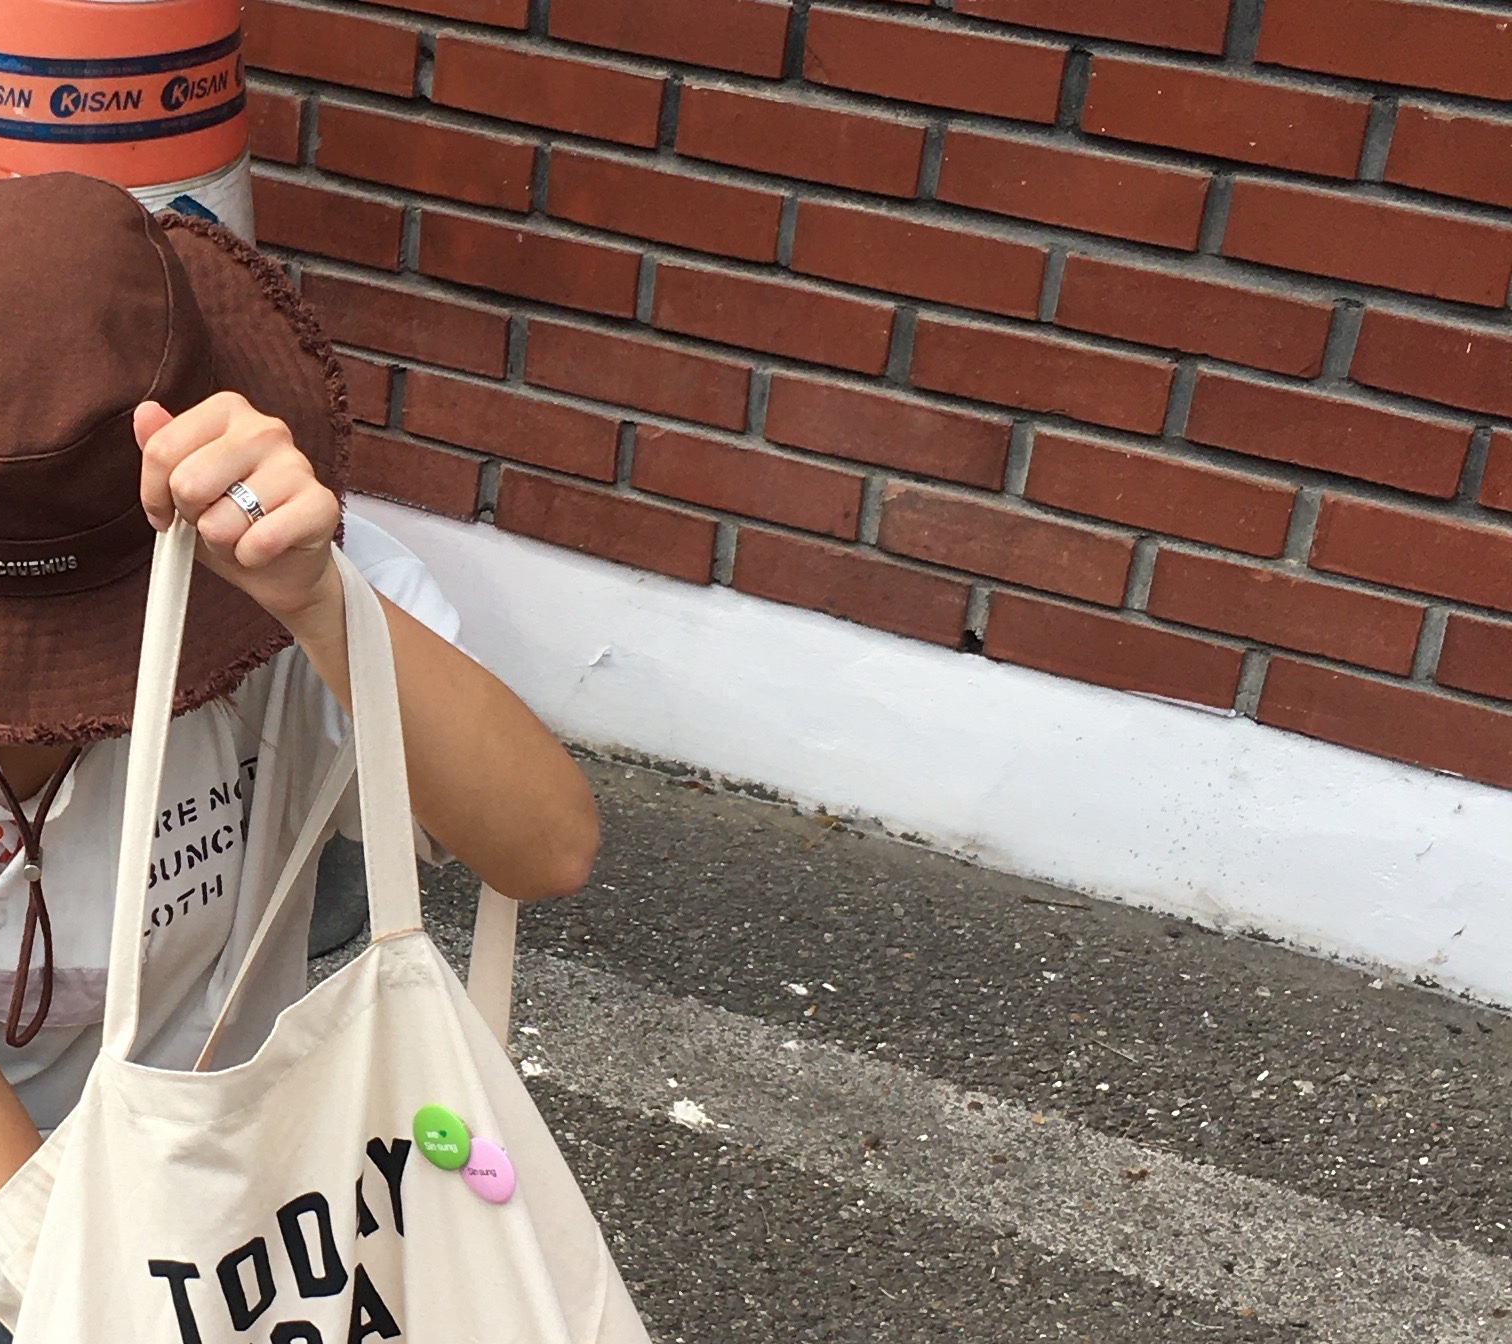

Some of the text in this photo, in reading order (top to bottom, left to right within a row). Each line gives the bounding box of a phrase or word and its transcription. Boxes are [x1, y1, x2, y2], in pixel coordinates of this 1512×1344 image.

[49, 84, 142, 118] KISAN
[160, 71, 229, 111] KISAN
[144, 874, 223, 937] OTH
